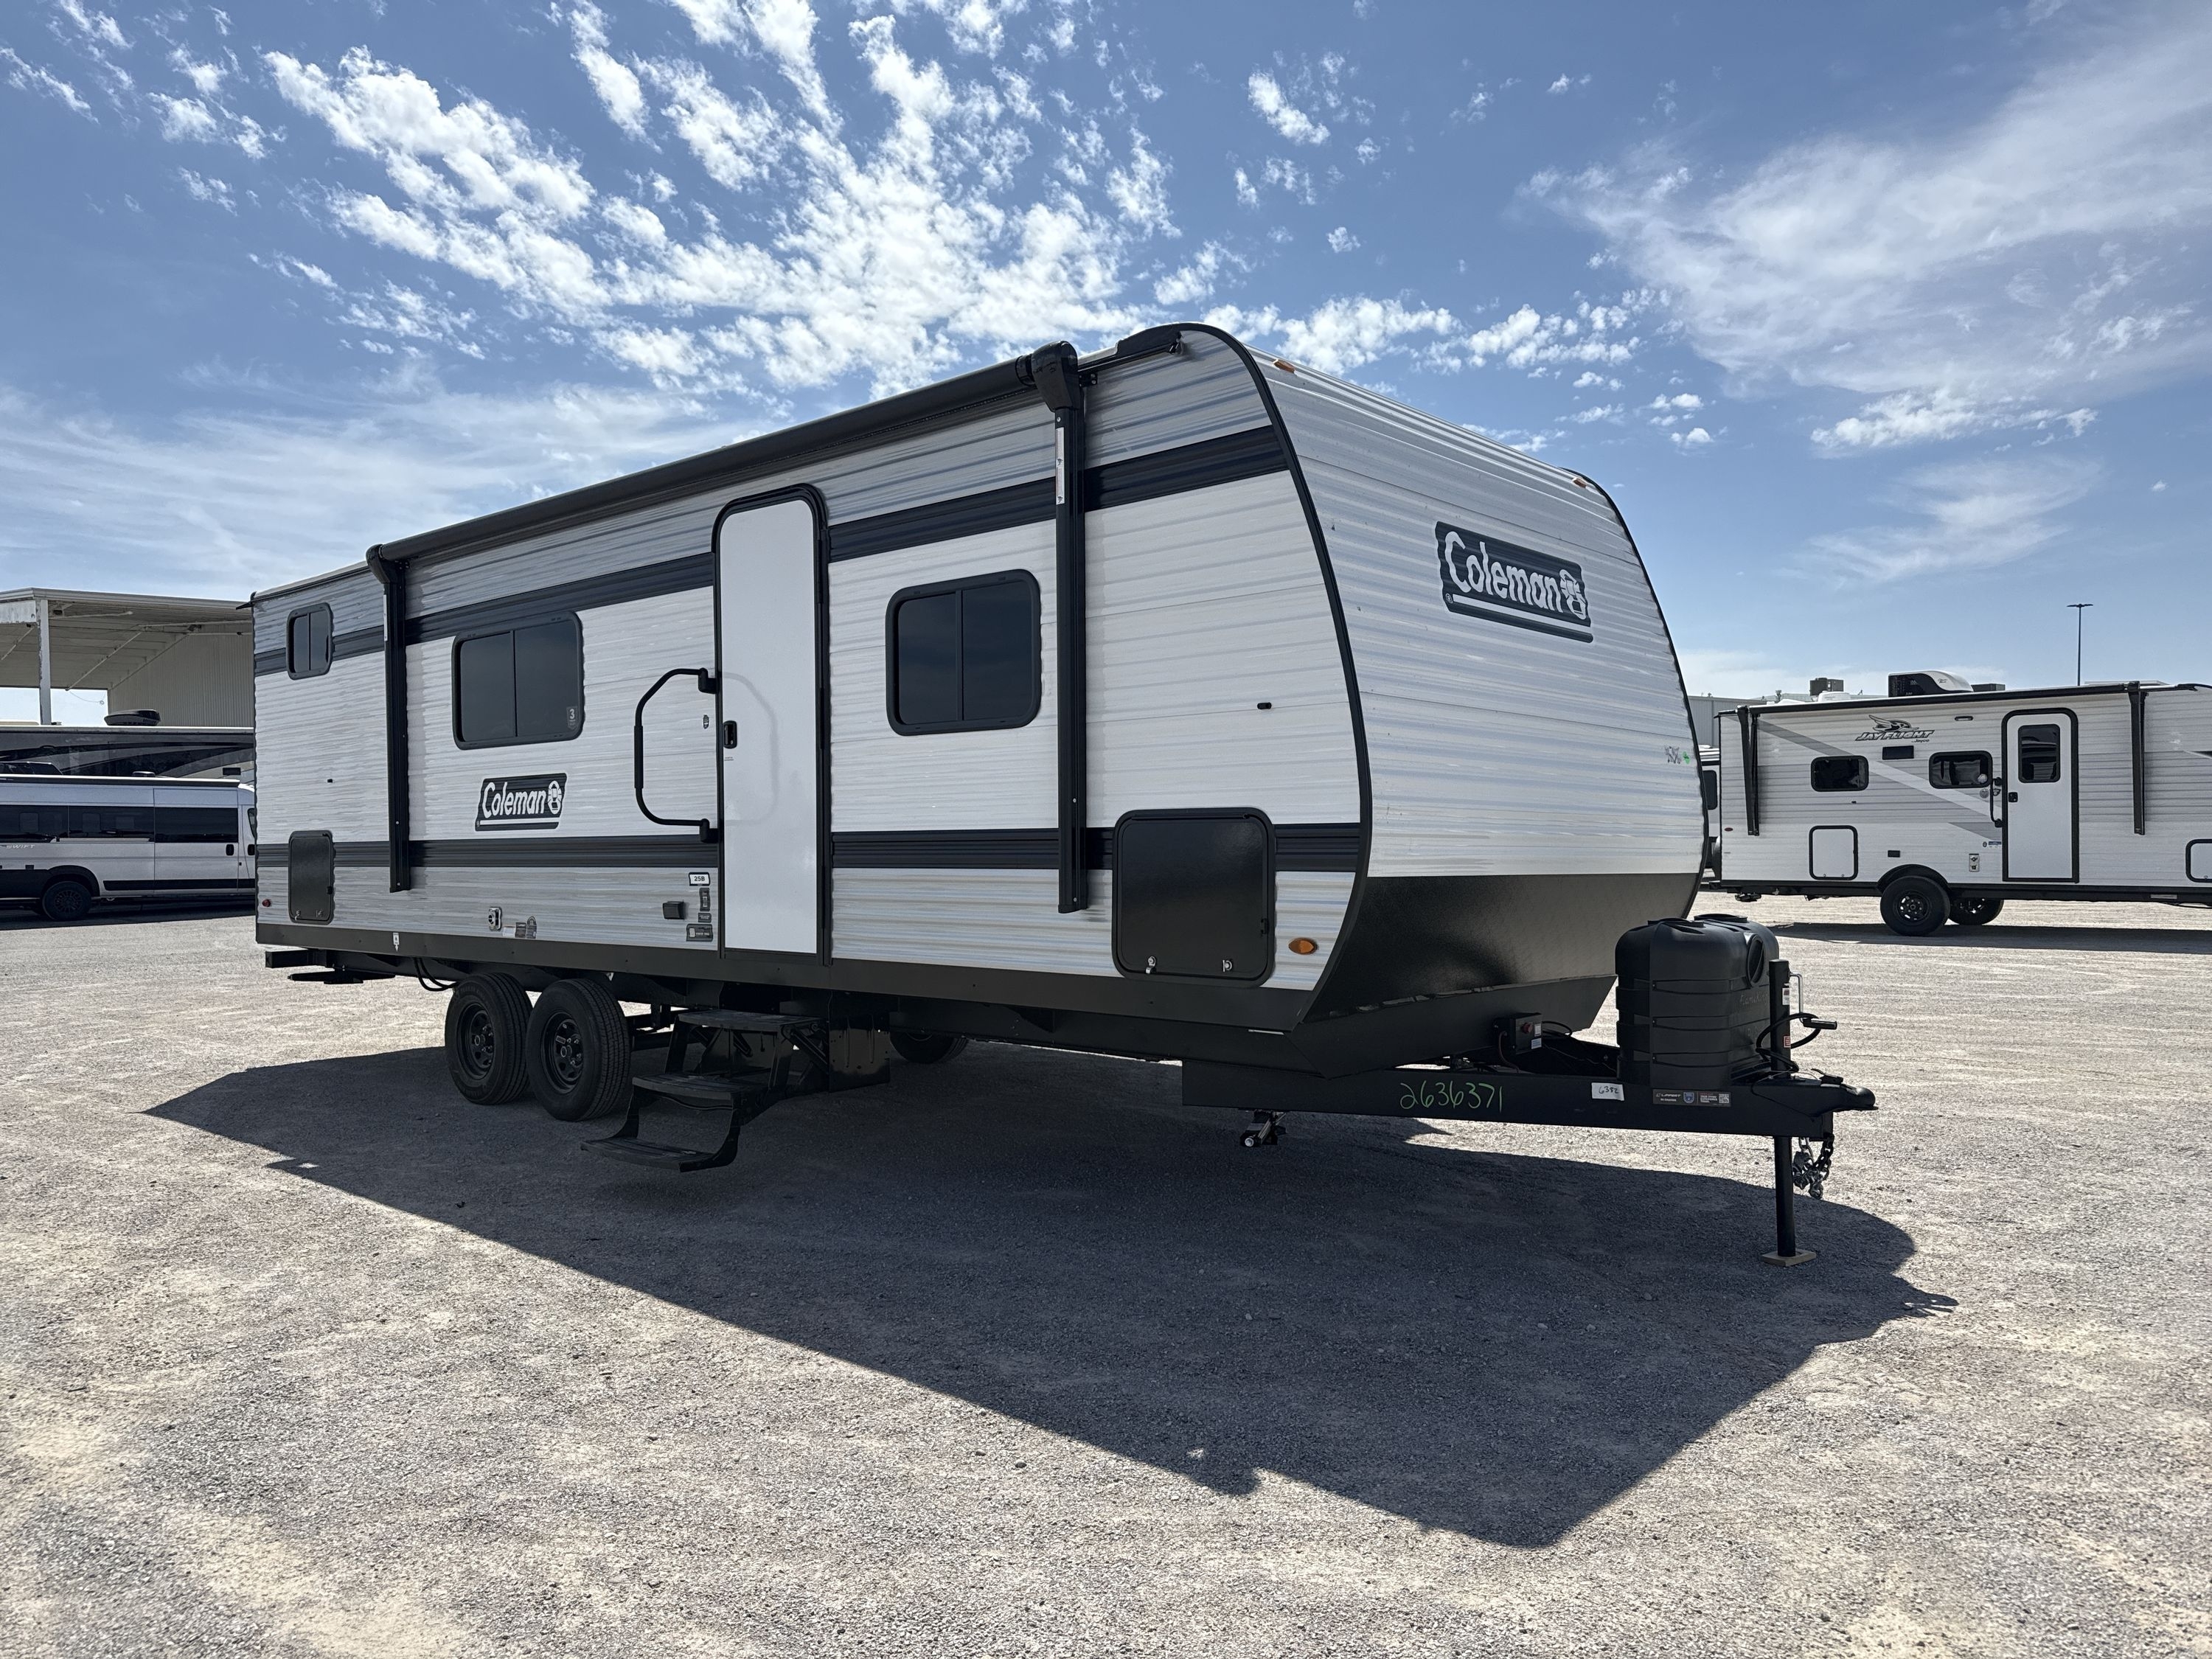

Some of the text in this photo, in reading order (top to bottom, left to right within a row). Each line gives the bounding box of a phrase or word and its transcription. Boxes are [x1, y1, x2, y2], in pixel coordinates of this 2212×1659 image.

[1444, 531, 1564, 613] Coleman
[1855, 730, 1935, 741] JAY FLIGHT
[482, 782, 547, 818] Coleman
[1400, 1080, 1503, 1112] 2636371
